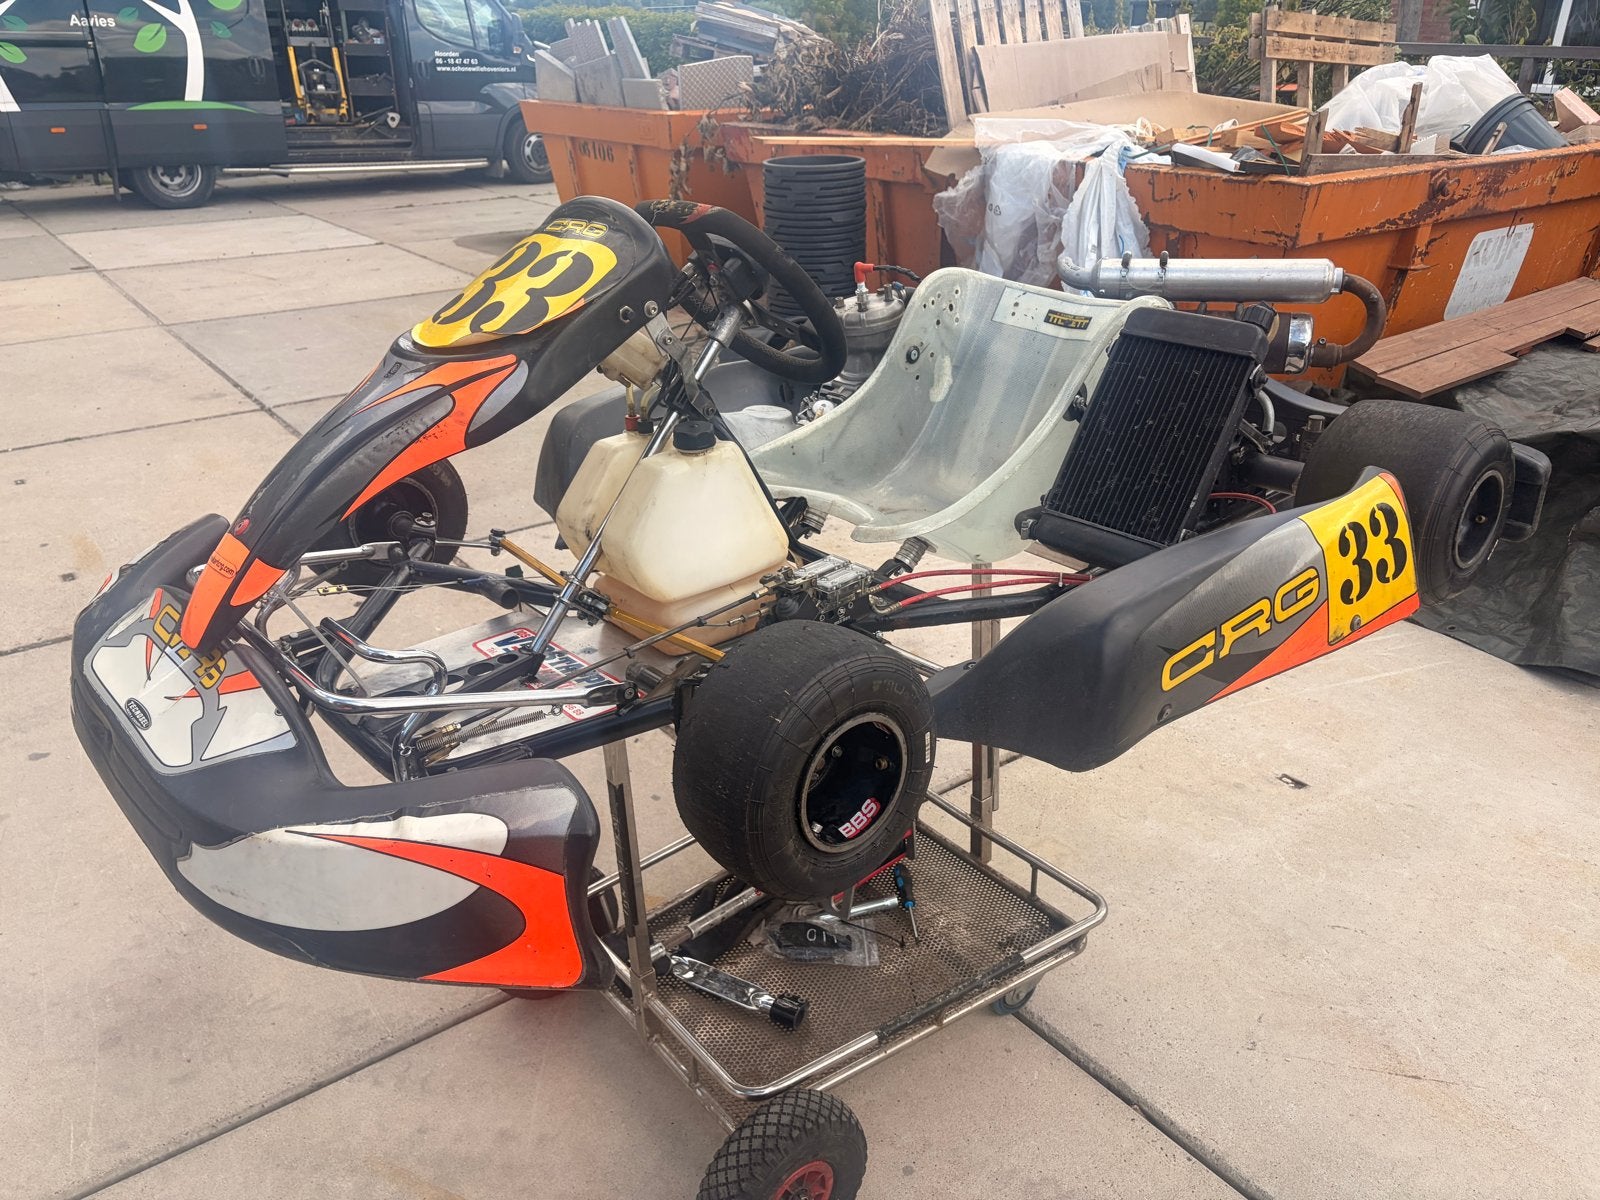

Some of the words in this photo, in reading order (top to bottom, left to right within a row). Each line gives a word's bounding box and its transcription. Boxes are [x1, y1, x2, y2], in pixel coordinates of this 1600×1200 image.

[544, 218, 609, 239] CRG
[431, 240, 594, 334] 33
[1048, 313, 1090, 328] TILETT
[1338, 502, 1408, 605] 33
[1160, 567, 1320, 692] CRG
[838, 797, 880, 839] BBS
